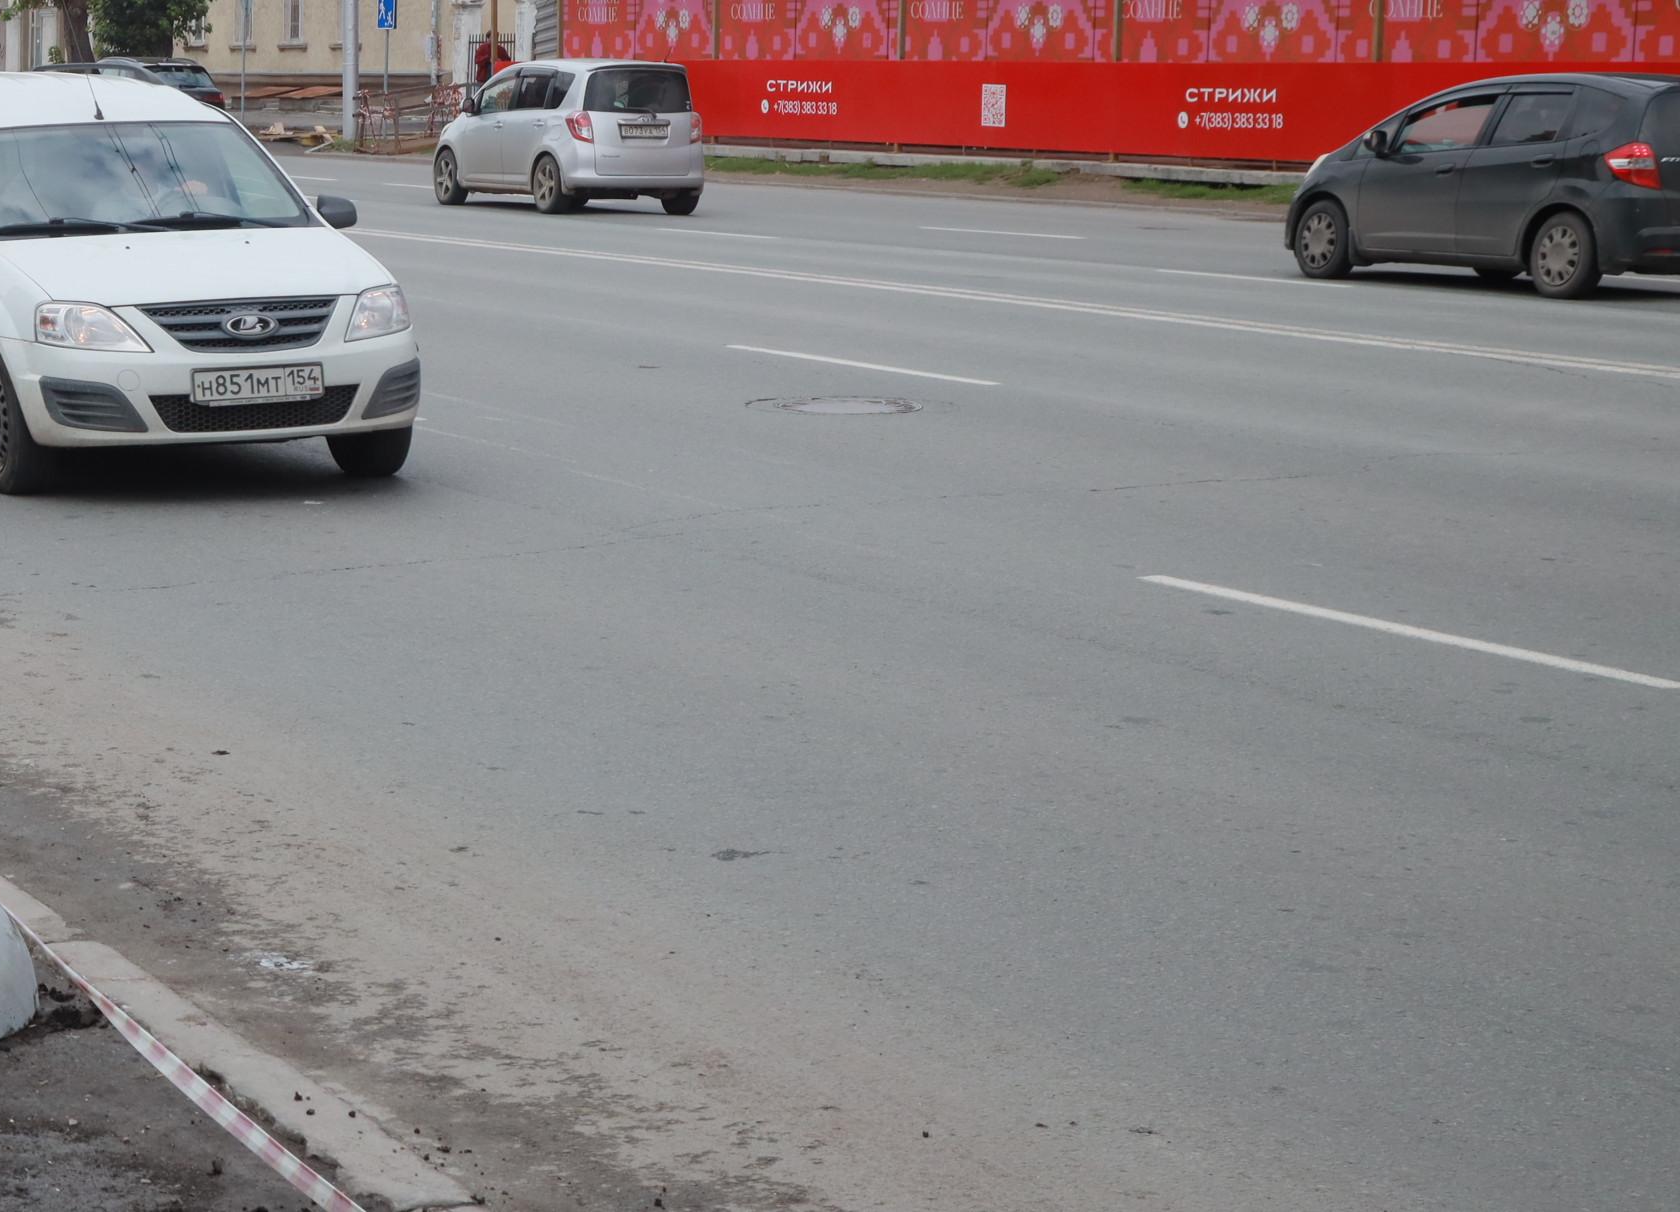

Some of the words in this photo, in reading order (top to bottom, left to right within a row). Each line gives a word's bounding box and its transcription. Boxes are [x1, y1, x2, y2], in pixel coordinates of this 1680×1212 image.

[576, 6, 619, 25] СОЛНЦЕ
[730, 4, 776, 21] СОЛНЦЕ
[910, 1, 965, 21] СОЛНЦЕ
[766, 79, 833, 94] СТРИЖИ
[1185, 87, 1277, 103] СТРИЖИ
[773, 99, 801, 116] +7(383)
[801, 101, 817, 115] 383
[1194, 111, 1232, 131] +7(383)
[1233, 112, 1254, 129] 383
[200, 373, 282, 398] Н851МТ
[287, 368, 318, 386] 154
